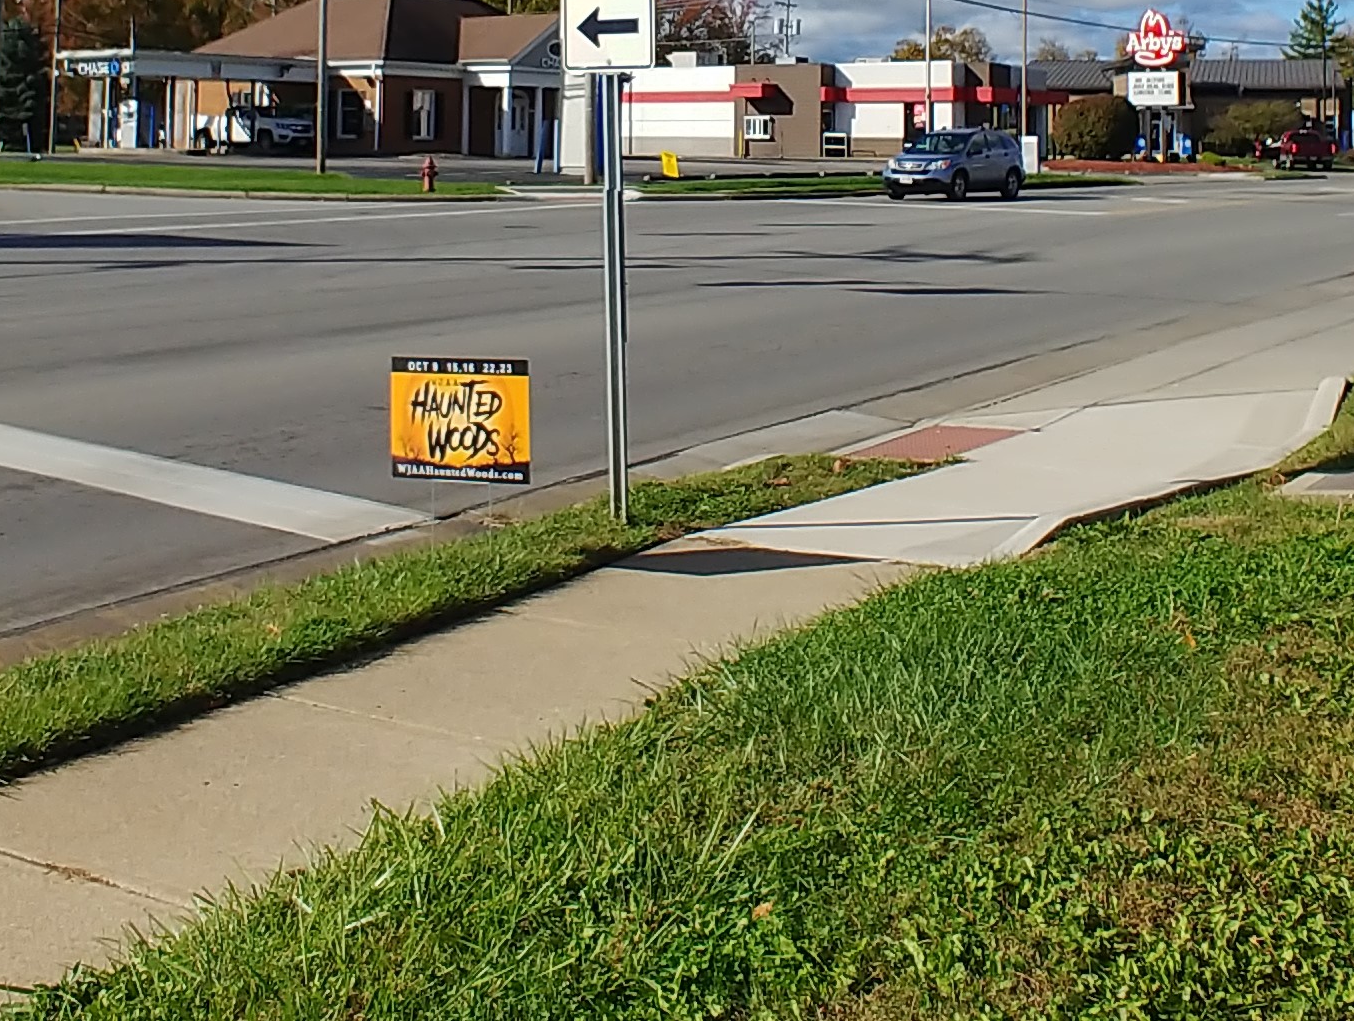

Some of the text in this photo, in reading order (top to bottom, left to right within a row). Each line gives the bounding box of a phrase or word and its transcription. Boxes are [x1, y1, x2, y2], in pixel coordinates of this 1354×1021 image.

[1126, 30, 1183, 55] Arby's
[407, 361, 430, 372] OCT
[410, 379, 503, 426] HAUNTED
[426, 417, 501, 463] WOODS
